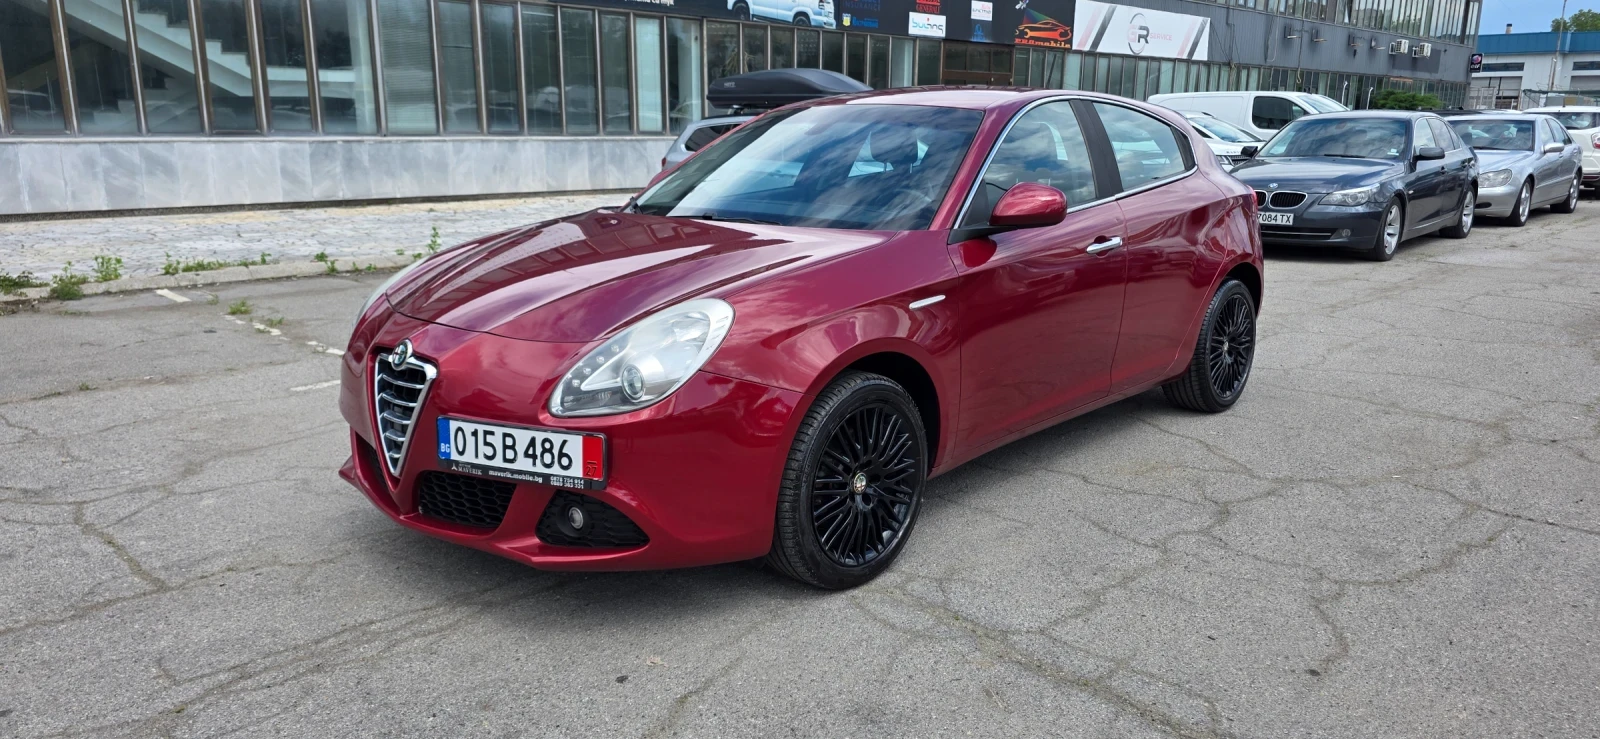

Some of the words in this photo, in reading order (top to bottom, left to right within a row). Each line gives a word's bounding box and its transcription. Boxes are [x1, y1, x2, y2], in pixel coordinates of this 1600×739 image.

[1149, 32, 1173, 42] SERVICE
[1279, 214, 1292, 224] TX
[440, 443, 451, 453] BG
[453, 426, 497, 461] 015
[502, 432, 518, 464] B
[523, 436, 573, 471] 486
[585, 464, 598, 477] 27
[488, 470, 543, 483] maverik.mobile.bg
